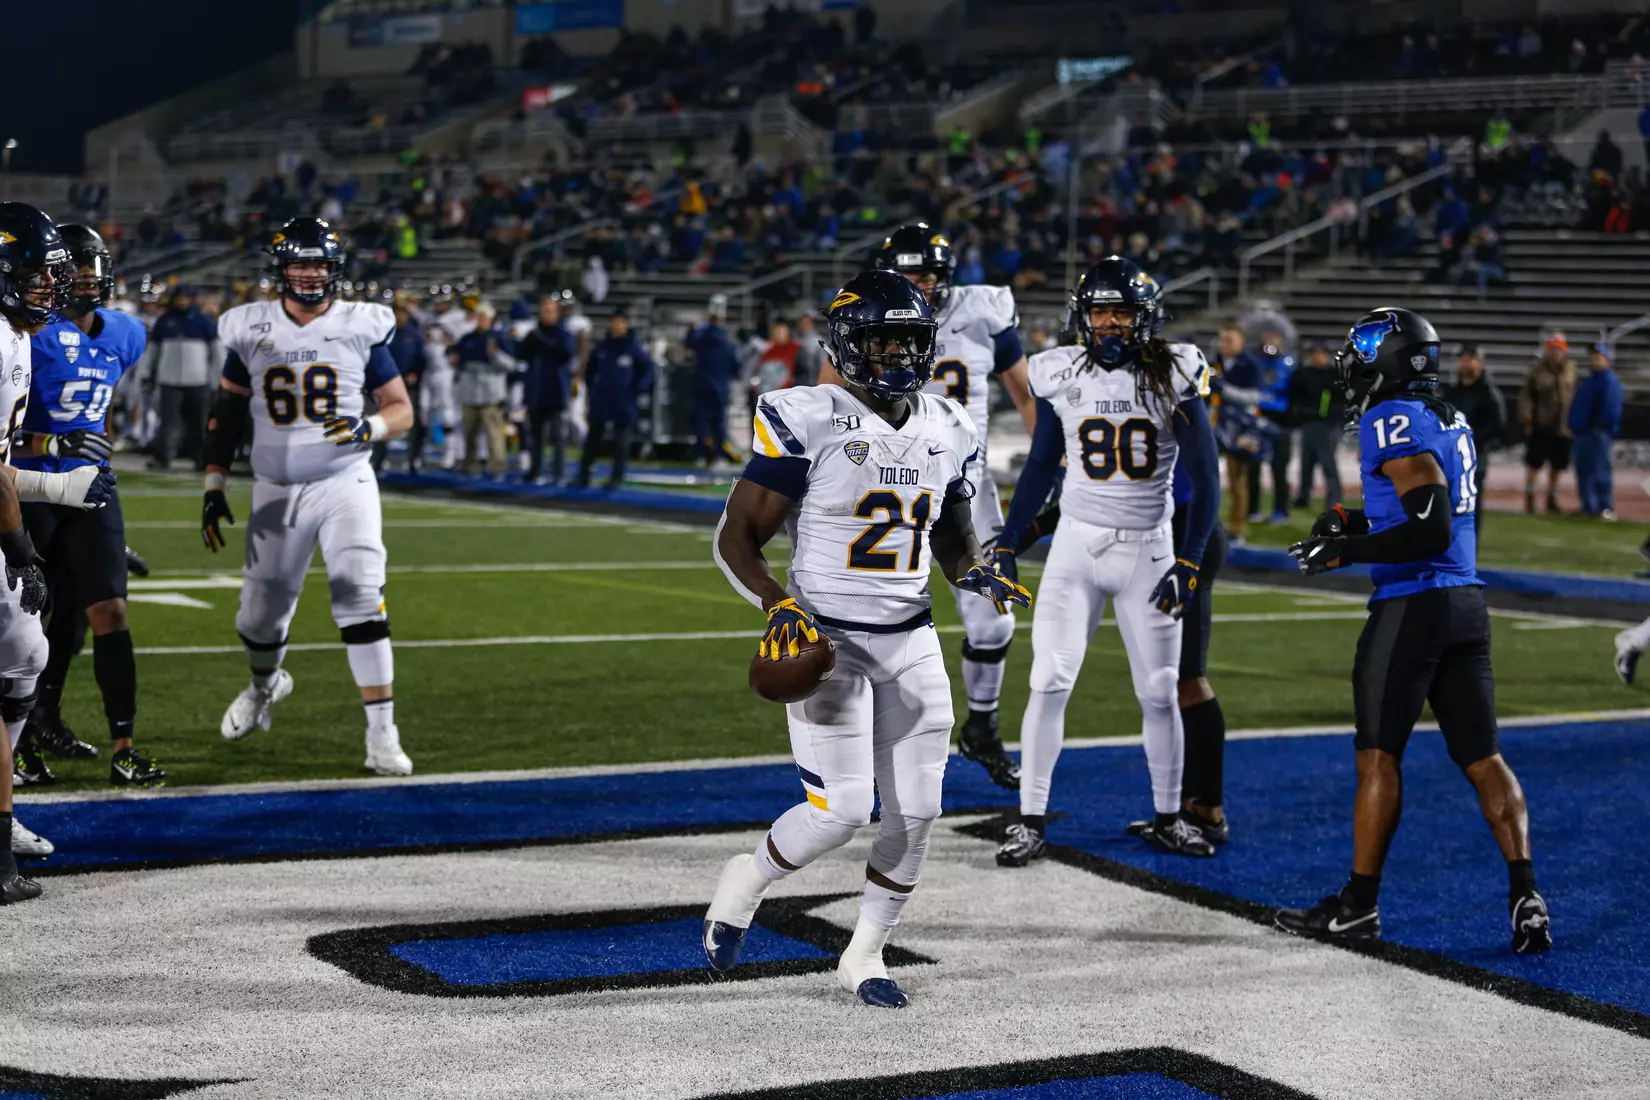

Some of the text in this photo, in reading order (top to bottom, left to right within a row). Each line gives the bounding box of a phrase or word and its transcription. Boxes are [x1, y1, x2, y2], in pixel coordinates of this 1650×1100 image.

[285, 350, 318, 364] TOLEDO
[48, 380, 114, 422] 50
[263, 363, 338, 426] 68
[1095, 400, 1132, 415] TOLEDO
[1078, 416, 1159, 482] 80
[1372, 414, 1412, 451] 12
[847, 447, 868, 457] MAC
[879, 466, 919, 486] TOLEDO
[848, 489, 933, 573] 21
